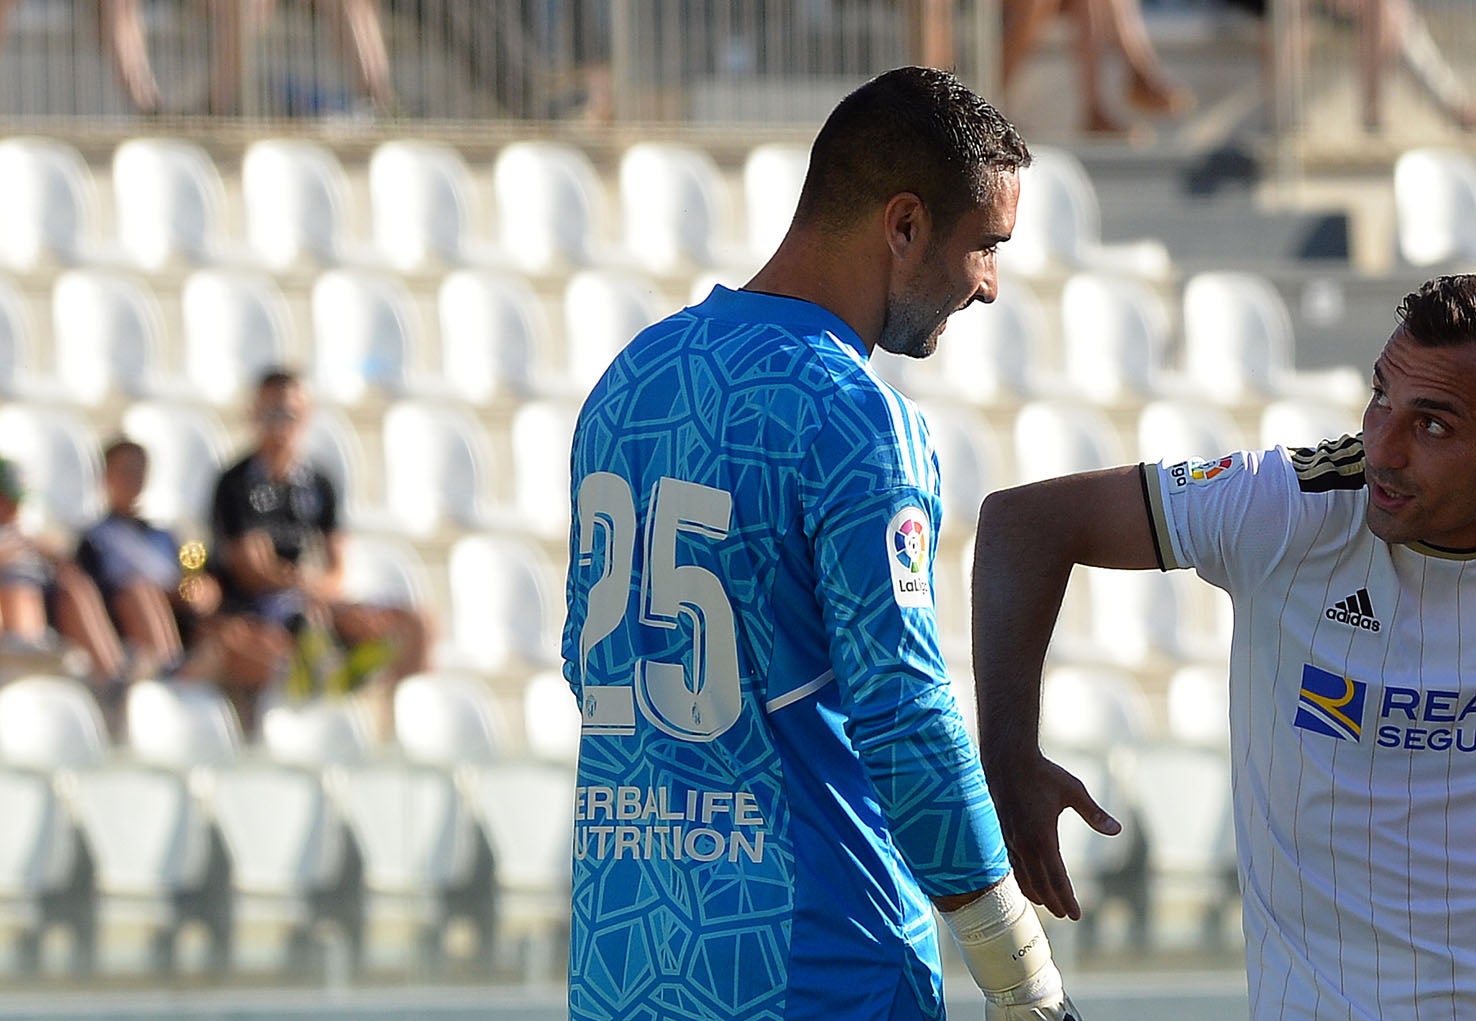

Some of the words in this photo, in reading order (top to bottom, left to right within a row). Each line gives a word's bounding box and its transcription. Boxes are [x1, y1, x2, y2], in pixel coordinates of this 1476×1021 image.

[577, 471, 741, 742] 25
[1325, 607, 1381, 632] adidas
[575, 786, 764, 825] ERBALIFE
[574, 826, 765, 863] UTRITION
